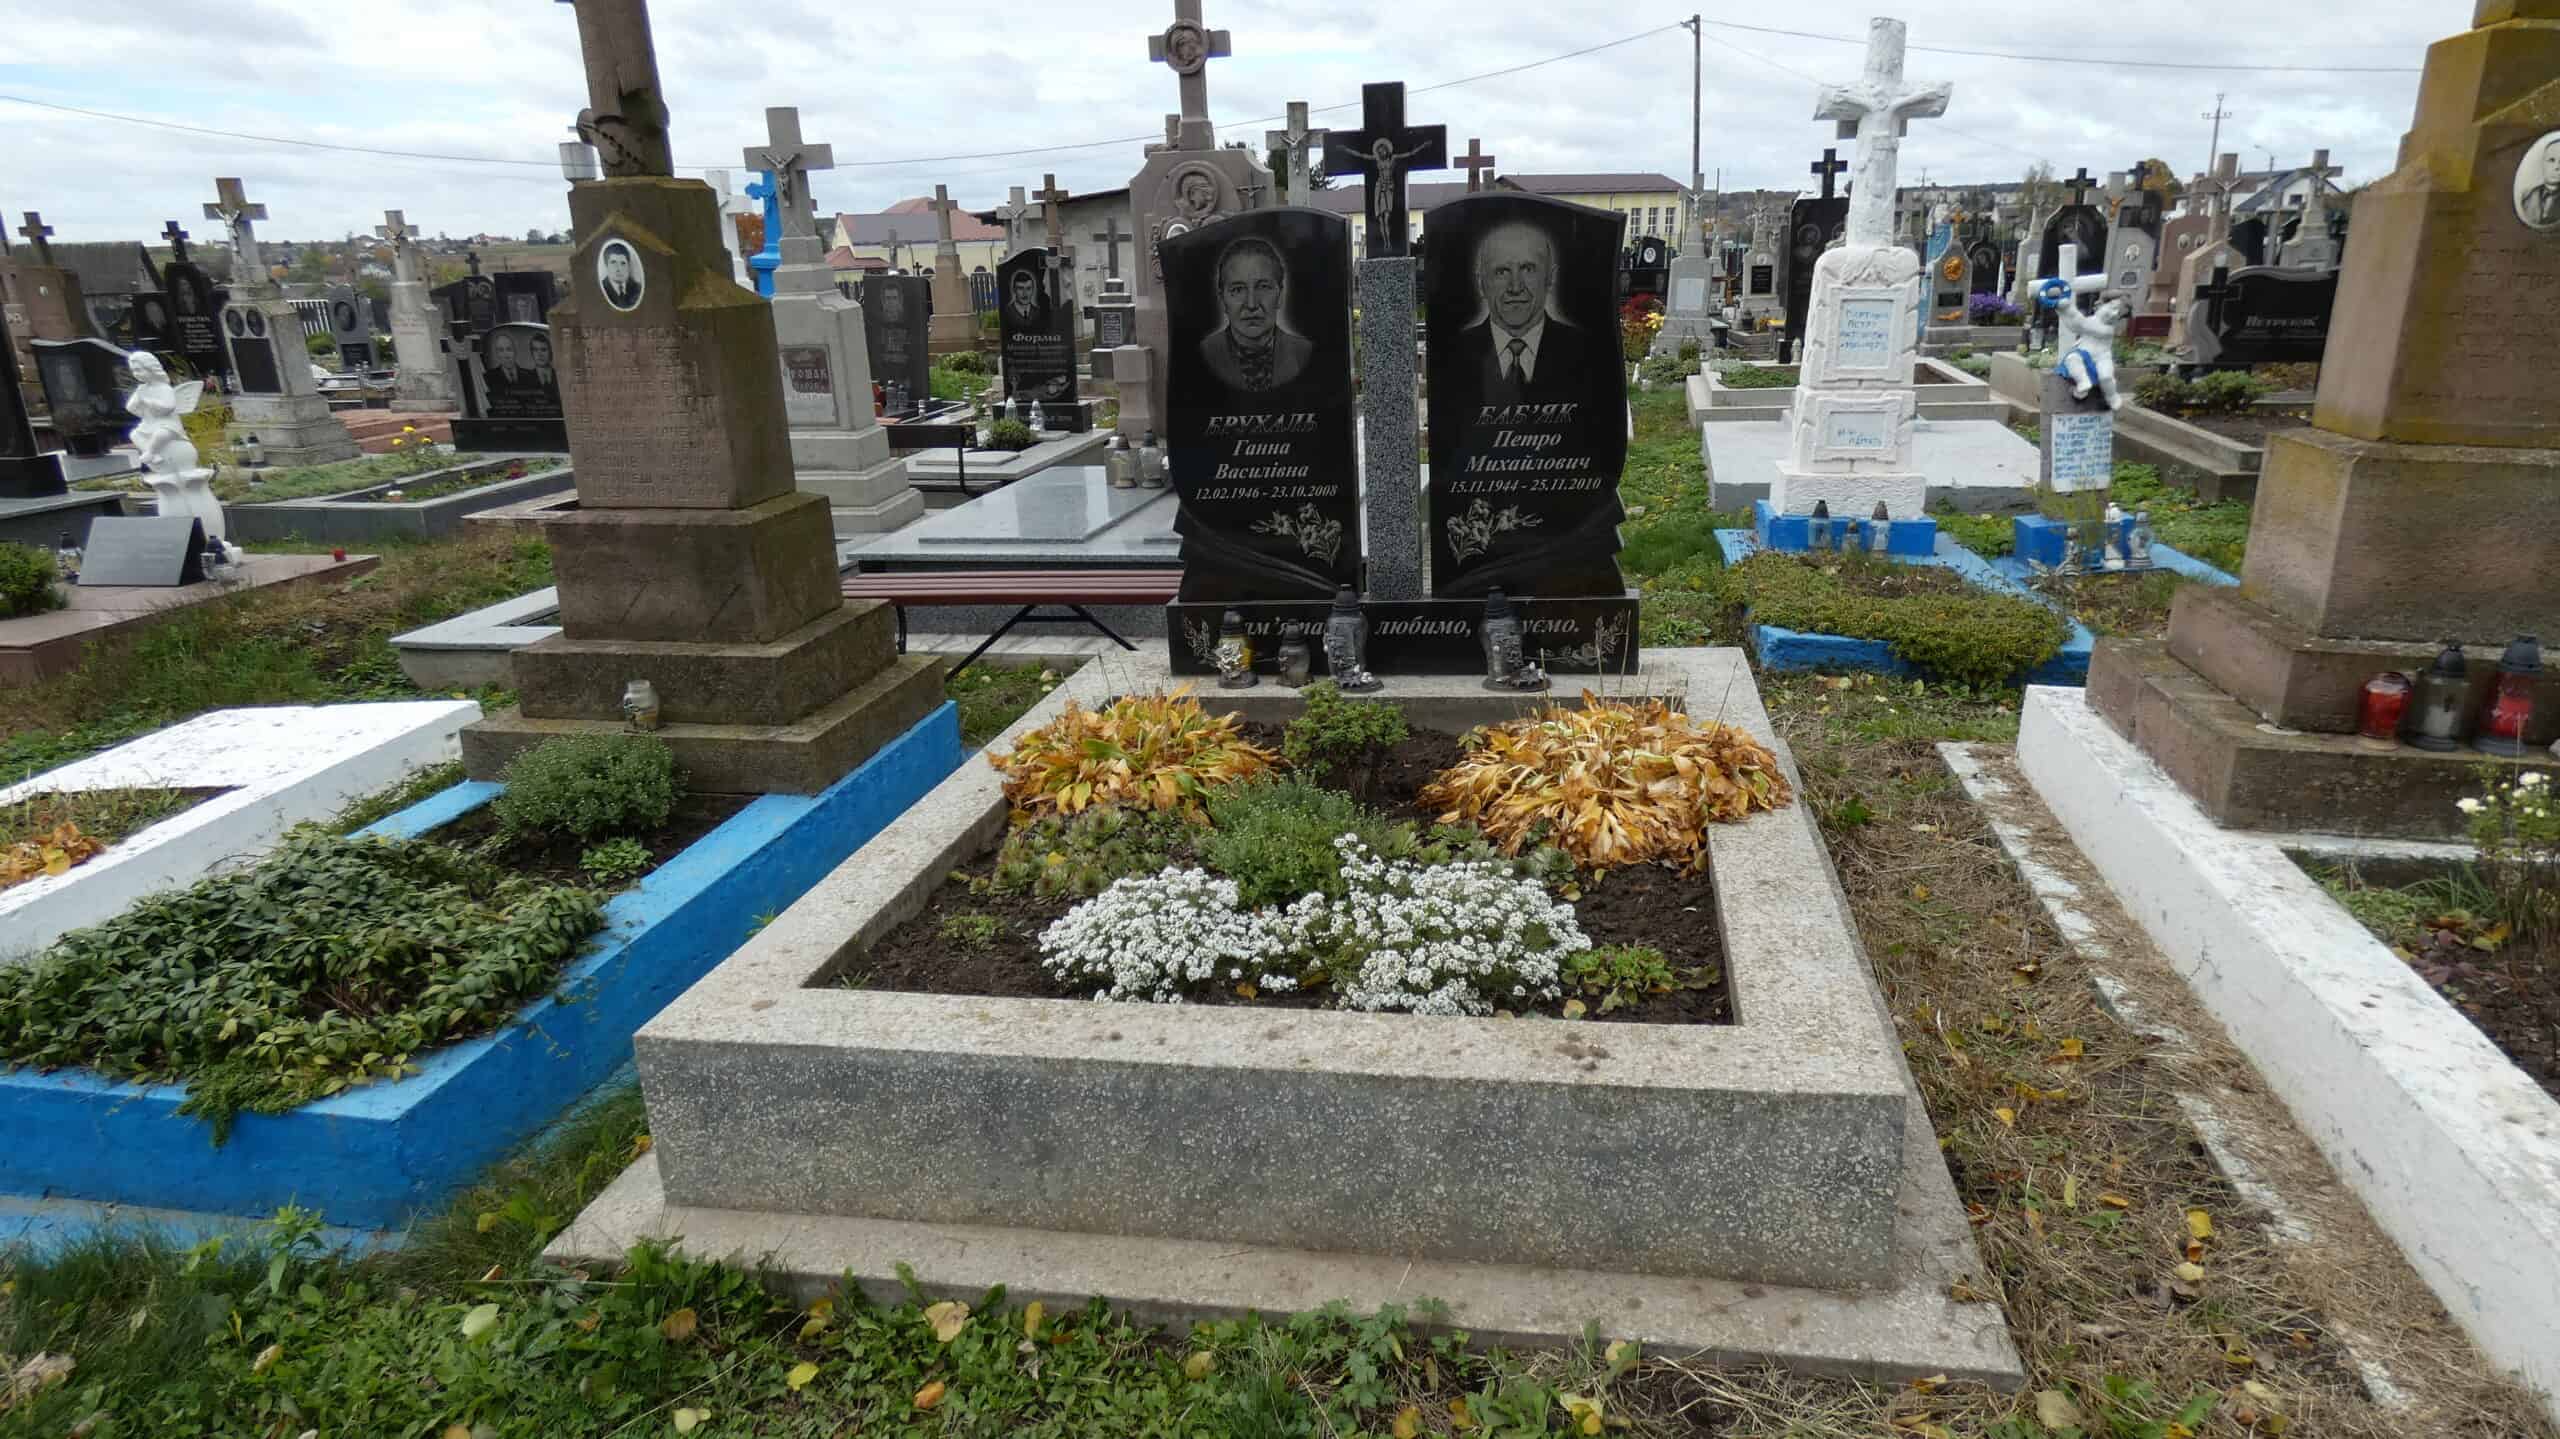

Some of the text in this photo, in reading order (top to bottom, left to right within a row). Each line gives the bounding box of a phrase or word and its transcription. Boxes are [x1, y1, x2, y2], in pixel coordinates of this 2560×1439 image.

[1207, 412, 1319, 433] БРУХАЛЬ
[1475, 402, 1578, 425] БАБ'ЯК
[1231, 439, 1291, 456] Ганна
[1492, 430, 1562, 451] Петро
[1215, 460, 1309, 480] Василівна
[1463, 455, 1592, 472] Михайлович
[1195, 487, 1261, 500] 12.02.1946
[1271, 484, 1338, 498] 23.10.2008
[1449, 480, 1520, 493] 15.11.1944
[1530, 477, 1602, 491] 25.11.2010
[1374, 615, 1472, 637] любимо,
